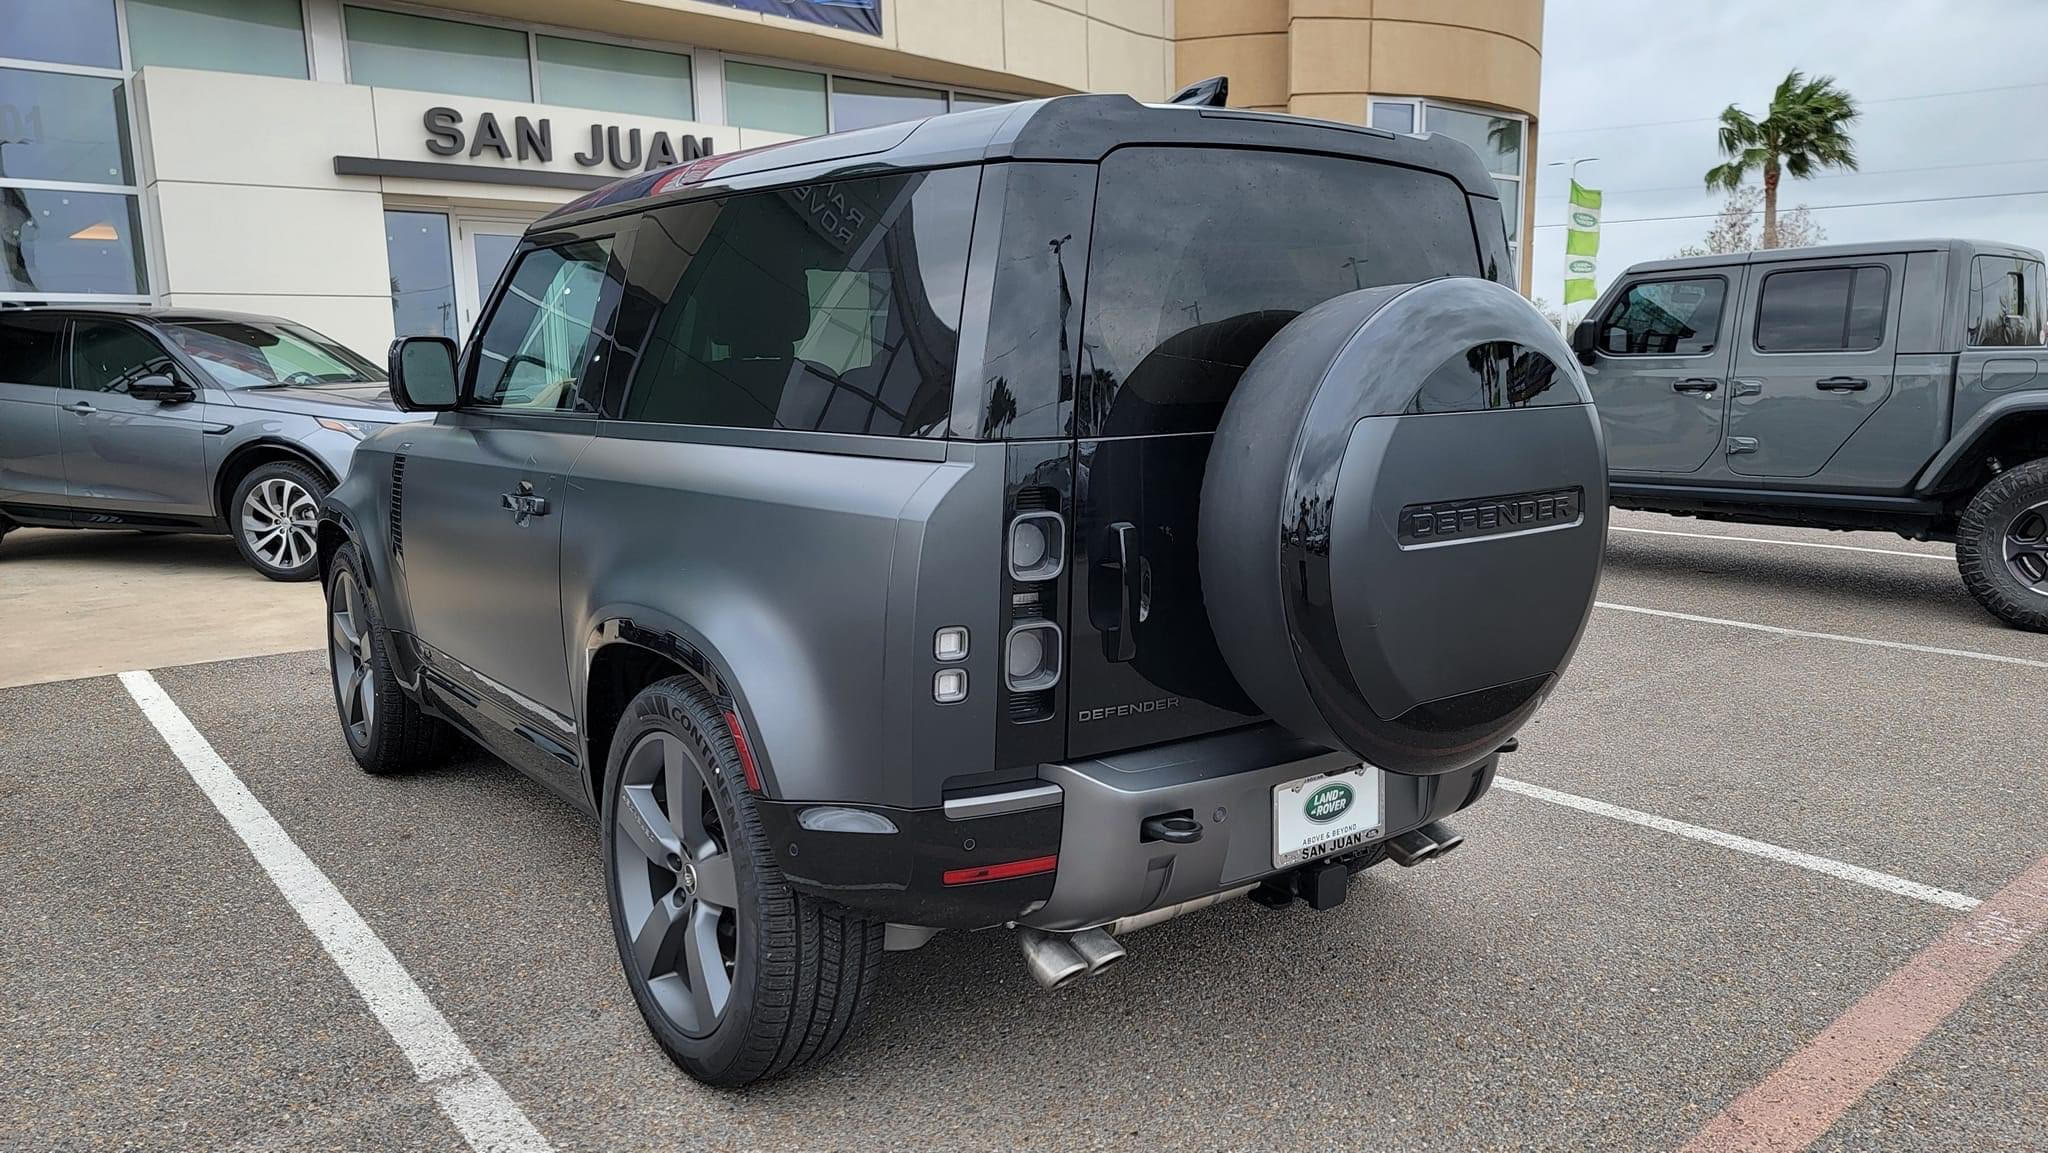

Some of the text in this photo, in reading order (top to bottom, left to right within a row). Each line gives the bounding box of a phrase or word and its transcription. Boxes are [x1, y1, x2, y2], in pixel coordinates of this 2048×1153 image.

[423, 106, 714, 172] SAN JUAN
[1411, 495, 1569, 538] DEFENDER
[1078, 696, 1180, 723] DEFENDER
[671, 706, 745, 850] CONTINENT
[1313, 790, 1339, 806] LAND
[1316, 798, 1347, 817] ROVER
[1302, 833, 1324, 846] ABOVE
[1326, 831, 1331, 839] &
[1332, 824, 1357, 837] BEYOND
[1302, 843, 1326, 859] SAN
[1330, 833, 1362, 851] JUAN
